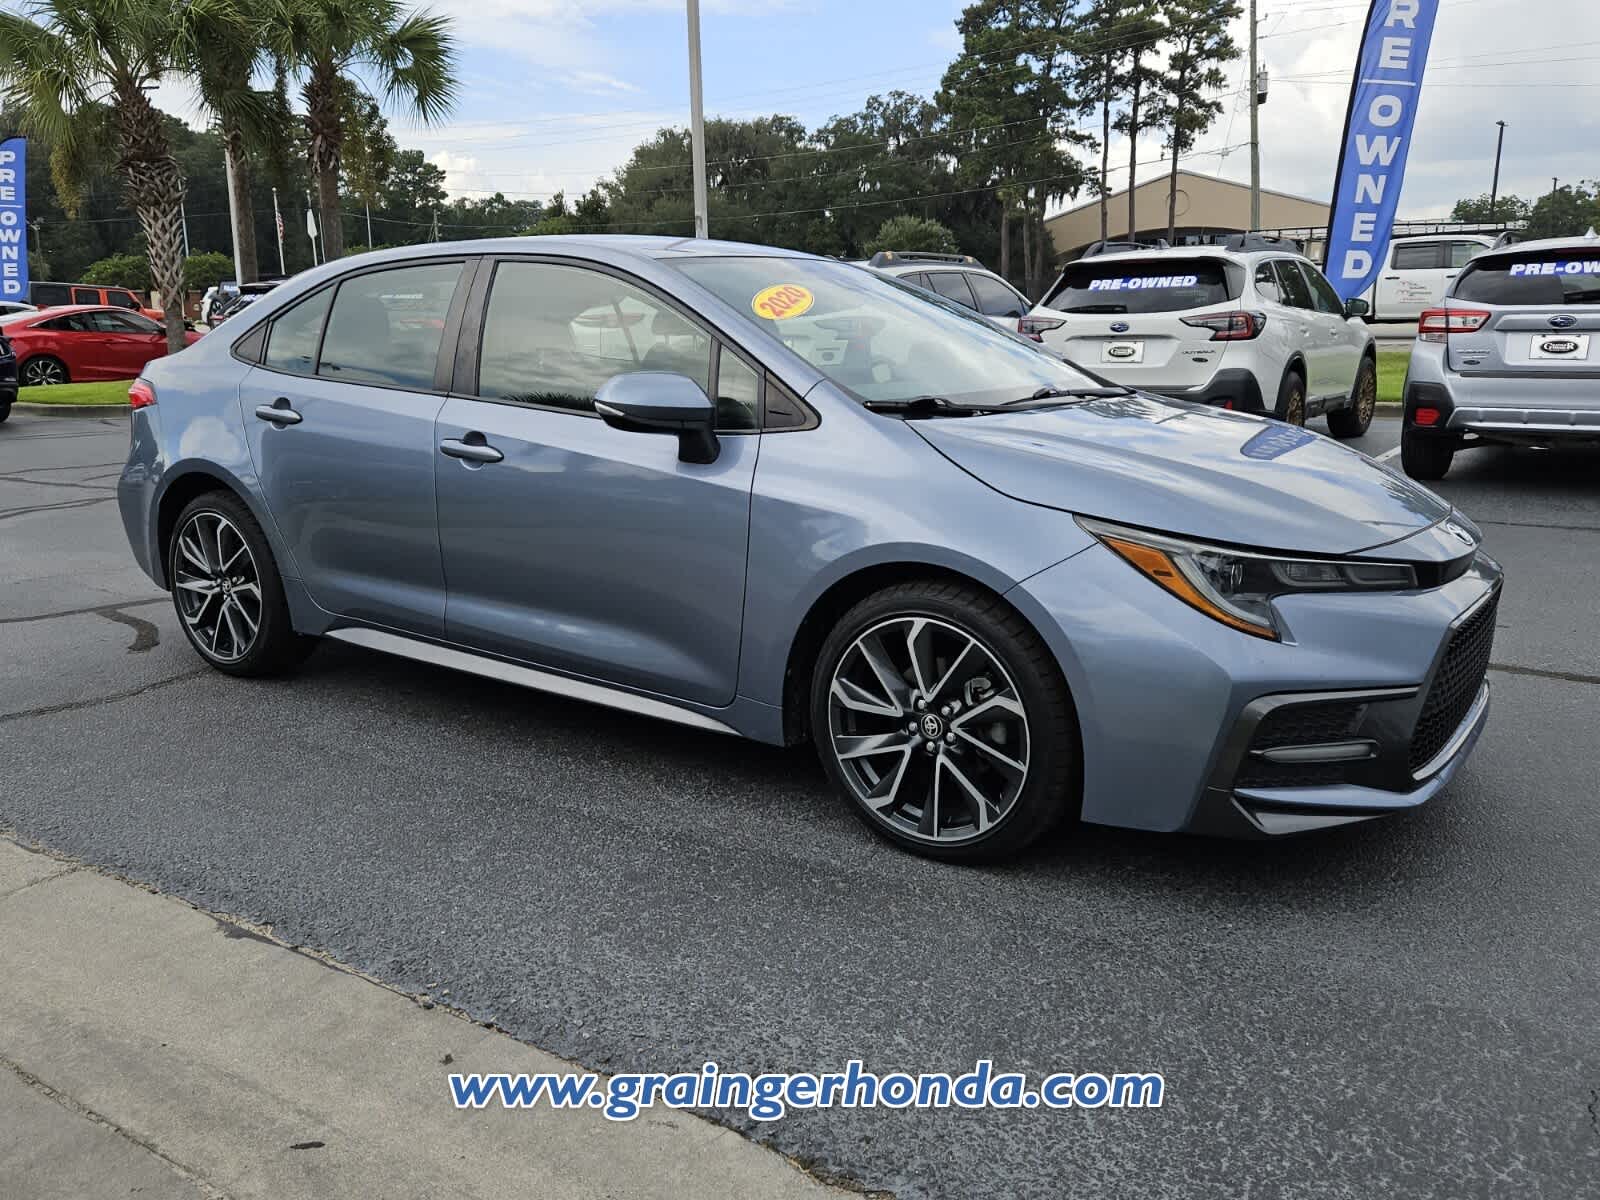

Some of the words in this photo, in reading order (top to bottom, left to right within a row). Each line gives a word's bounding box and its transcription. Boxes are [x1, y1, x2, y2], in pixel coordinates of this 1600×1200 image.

[1341, 94, 1402, 279] OWNED
[0, 211, 21, 294] OWNED
[759, 286, 806, 317] 2020
[1087, 275, 1198, 291] PRE-OWNED
